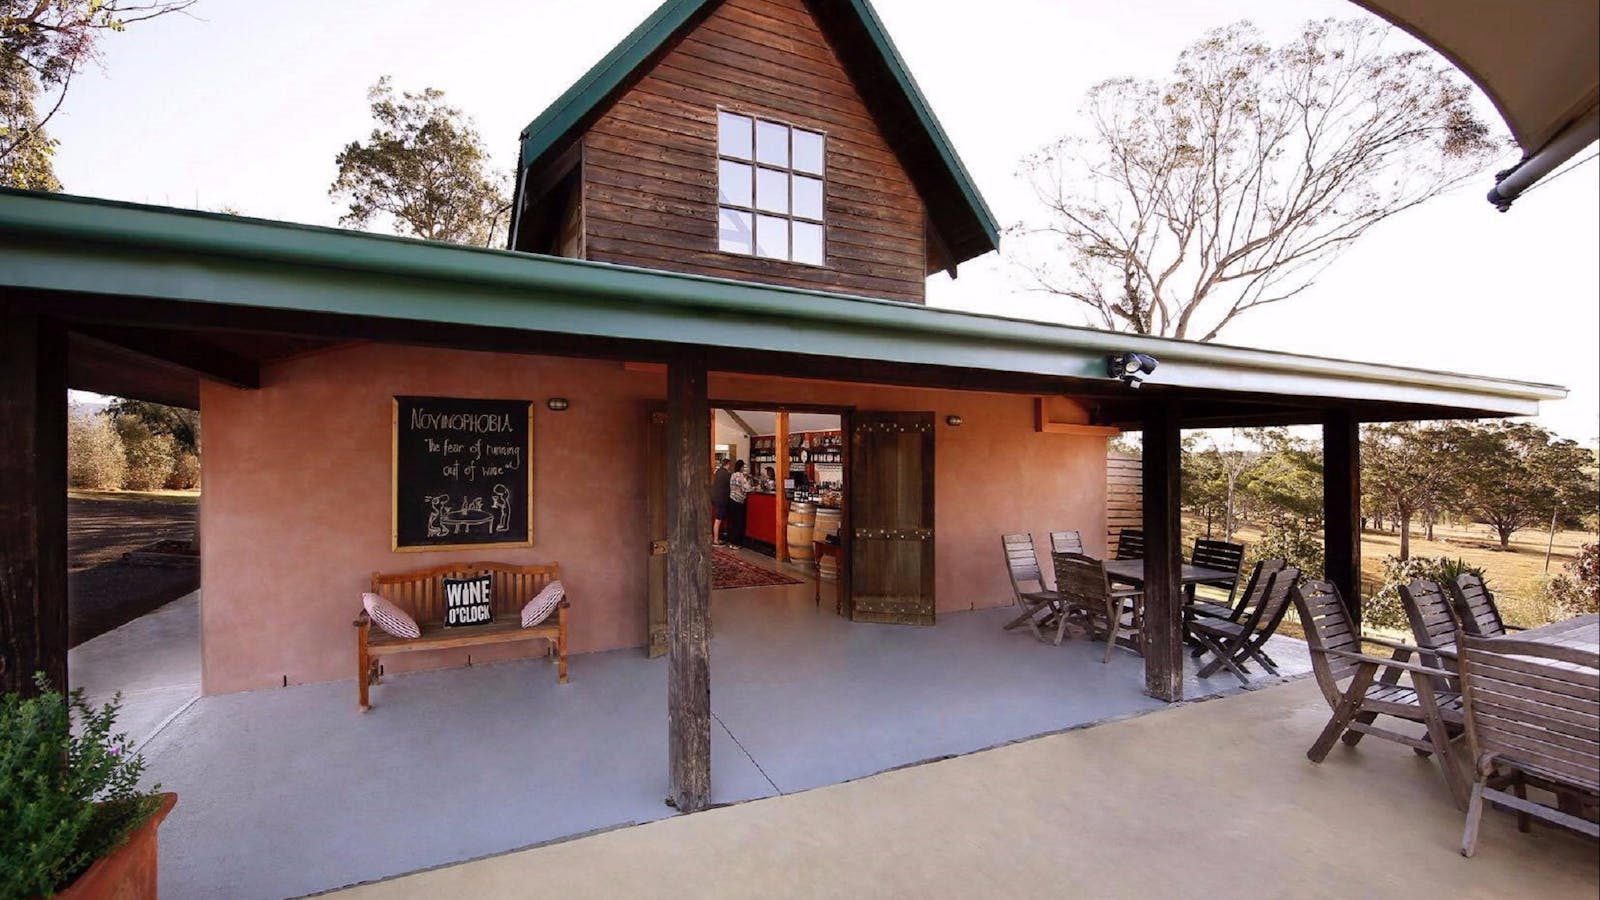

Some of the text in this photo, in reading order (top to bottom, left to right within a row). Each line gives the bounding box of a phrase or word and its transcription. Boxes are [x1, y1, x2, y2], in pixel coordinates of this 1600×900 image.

[411, 408, 513, 432] NOVINOPHOBIA
[443, 439, 465, 456] fear
[469, 439, 482, 460] of
[486, 442, 520, 469] running
[442, 460, 504, 481] out of wine
[447, 580, 490, 606] WINE
[449, 605, 490, 624] O'CLOCK
